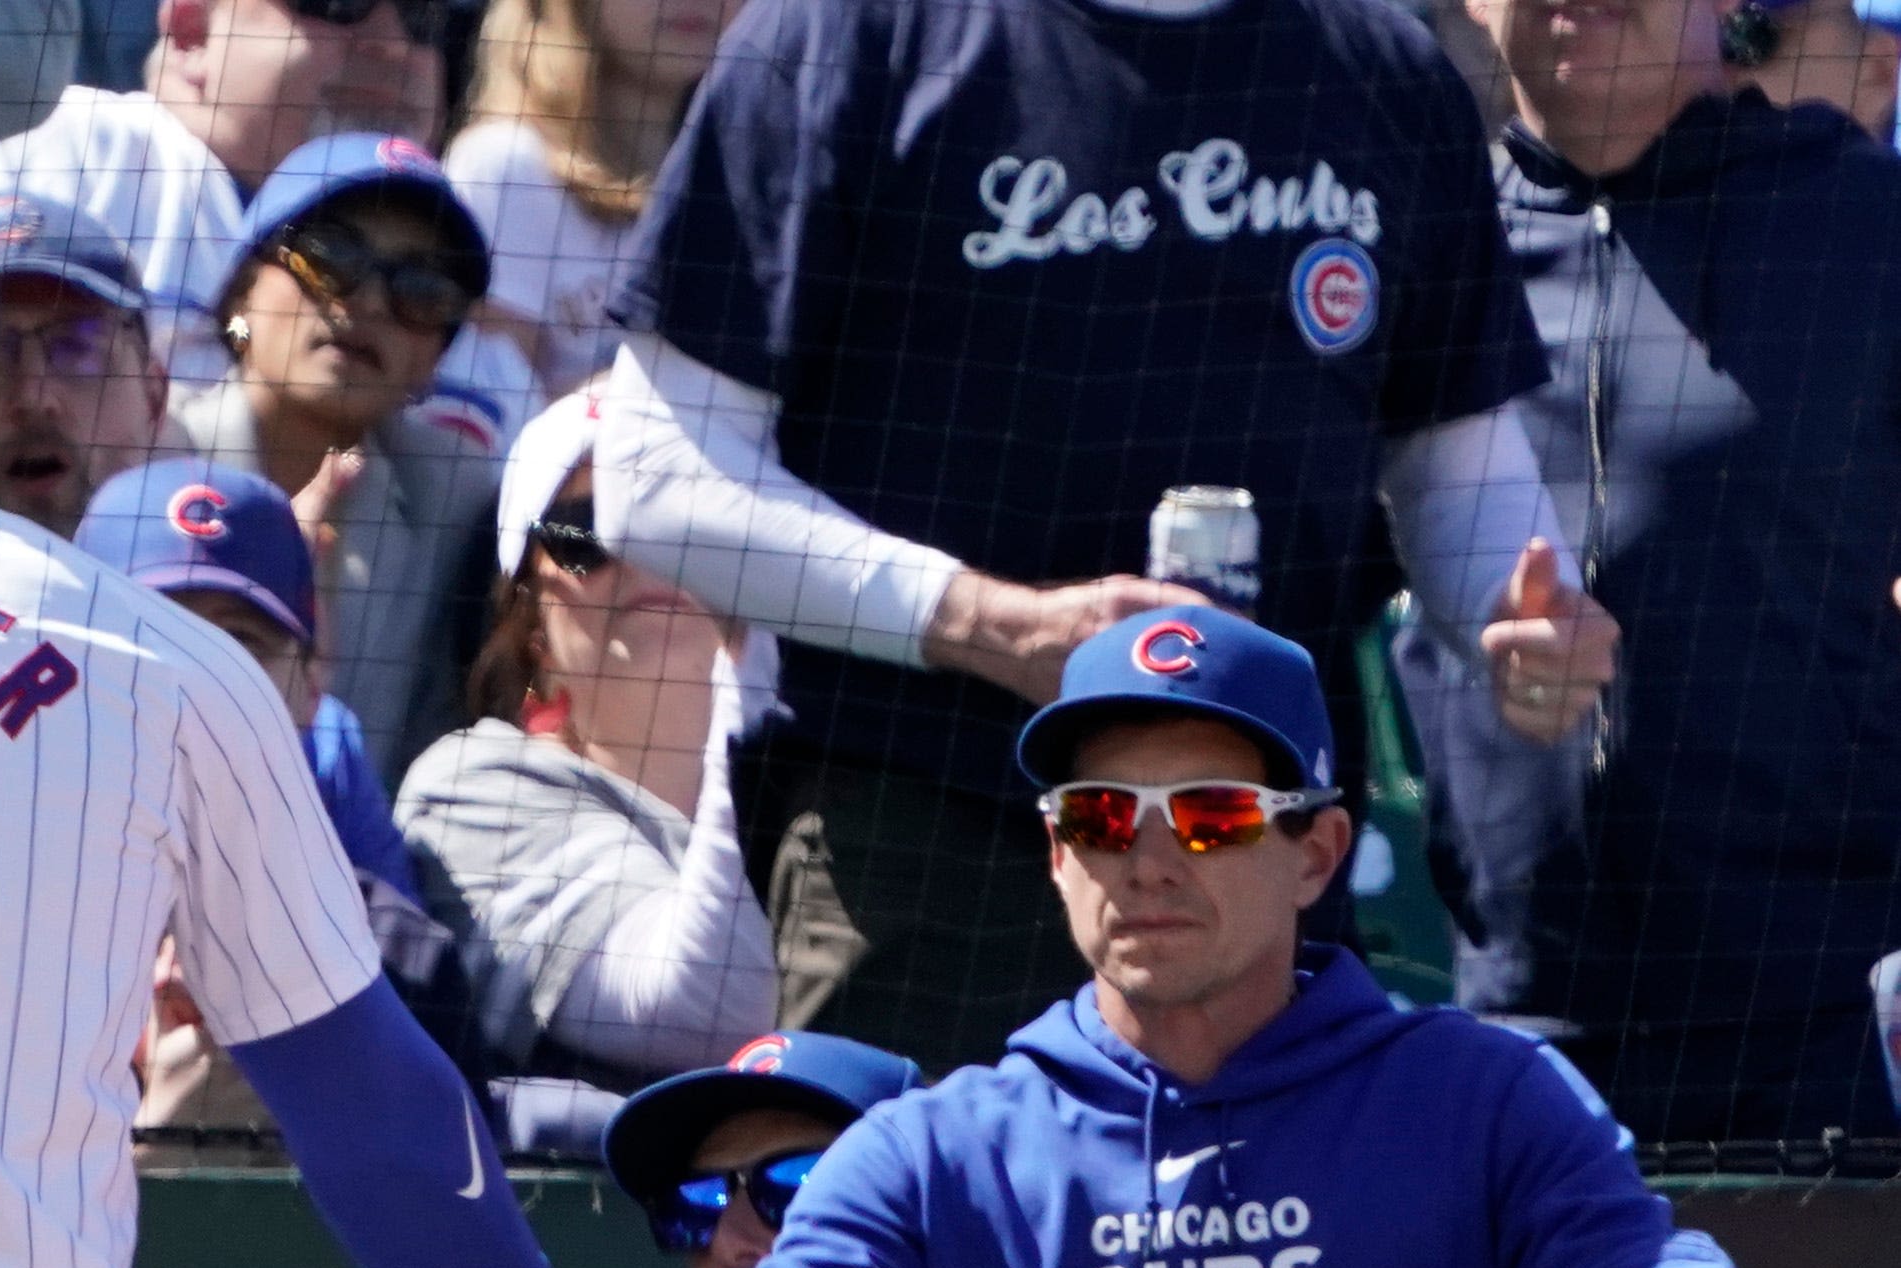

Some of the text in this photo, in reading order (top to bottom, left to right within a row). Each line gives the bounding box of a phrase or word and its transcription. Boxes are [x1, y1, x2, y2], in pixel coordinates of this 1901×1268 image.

[961, 137, 1382, 269] Los Cubs
[167, 483, 228, 540] C
[1130, 619, 1205, 678] C
[1091, 1196, 1311, 1257] CHICAGO
